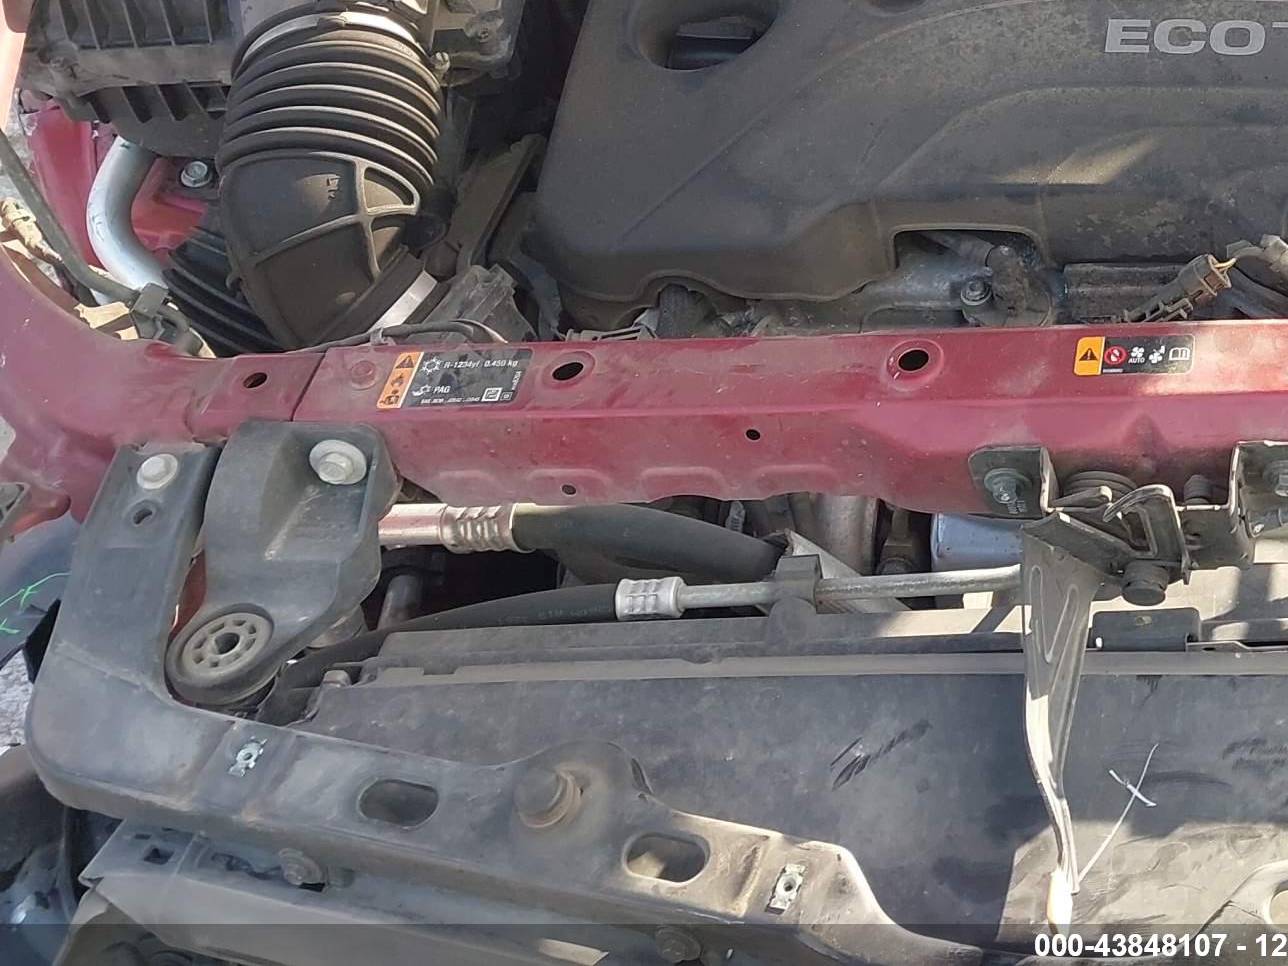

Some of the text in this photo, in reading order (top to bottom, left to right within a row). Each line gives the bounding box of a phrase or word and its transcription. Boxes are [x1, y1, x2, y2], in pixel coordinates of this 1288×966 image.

[443, 361, 480, 369] R-1234yf
[507, 360, 518, 368] kg
[433, 386, 451, 394] PAG
